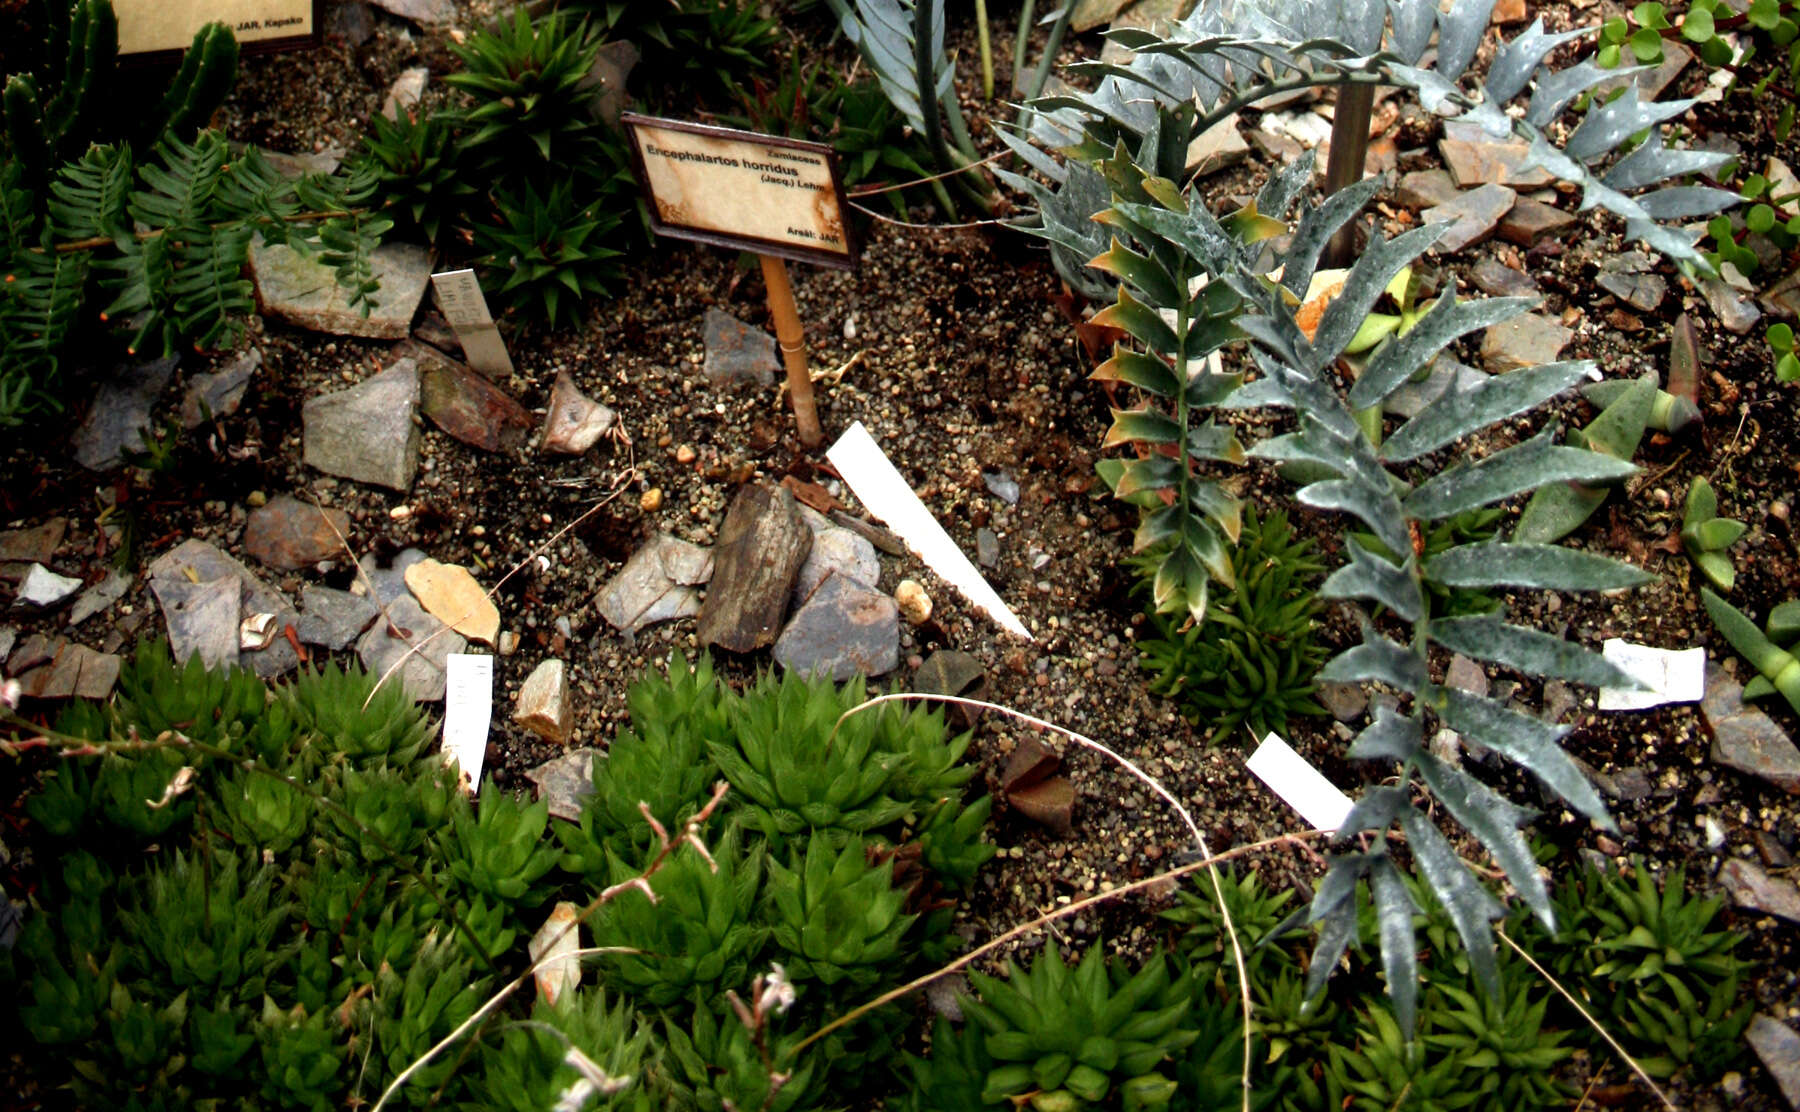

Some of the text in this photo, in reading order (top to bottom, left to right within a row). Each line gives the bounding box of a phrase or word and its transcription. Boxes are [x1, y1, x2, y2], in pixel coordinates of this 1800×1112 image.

[646, 144, 799, 176] Encephalartos horridus
[766, 149, 821, 165] Zamiaceae
